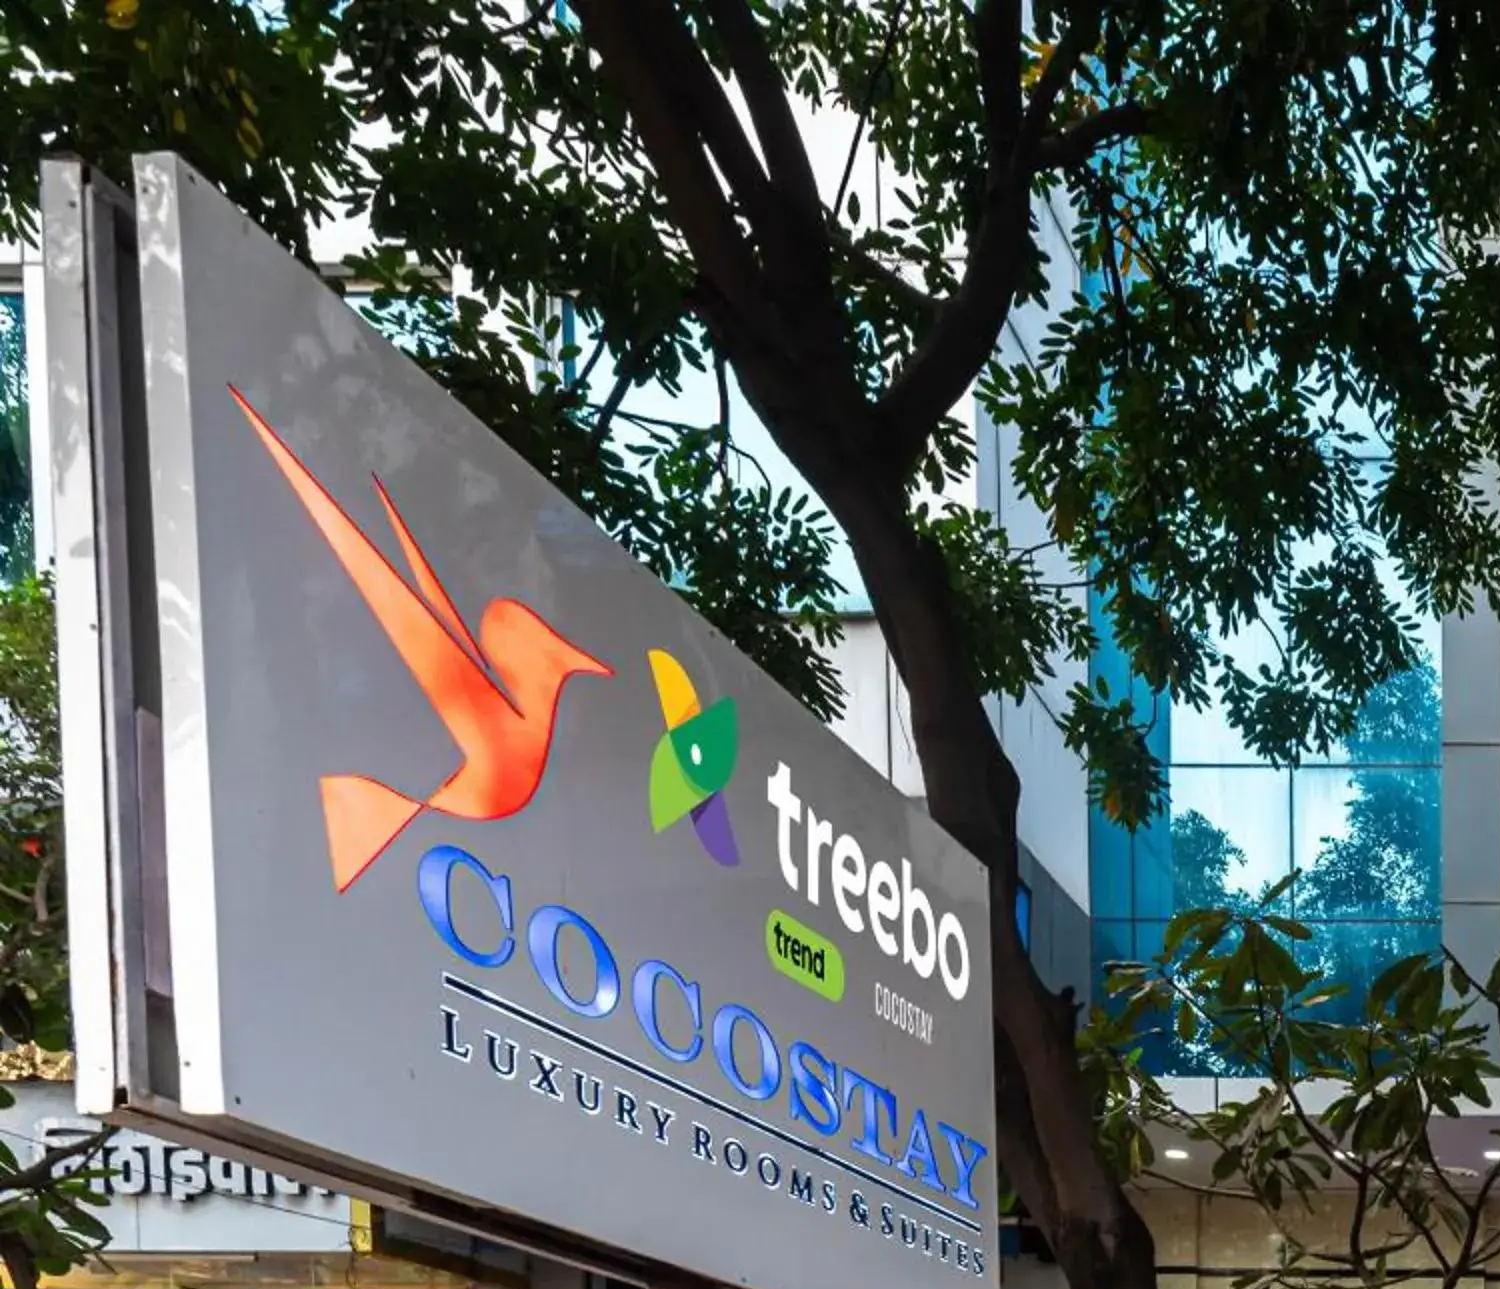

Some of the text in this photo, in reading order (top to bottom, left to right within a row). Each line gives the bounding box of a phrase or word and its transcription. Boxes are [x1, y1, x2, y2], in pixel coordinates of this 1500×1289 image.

[767, 761, 970, 1000] treebo
[773, 922, 826, 982] trend
[417, 843, 989, 1209] COCOSTAY
[875, 981, 933, 1045] COCOSTAY
[440, 1005, 985, 1277] LUXURY ROOMS & SUITES
